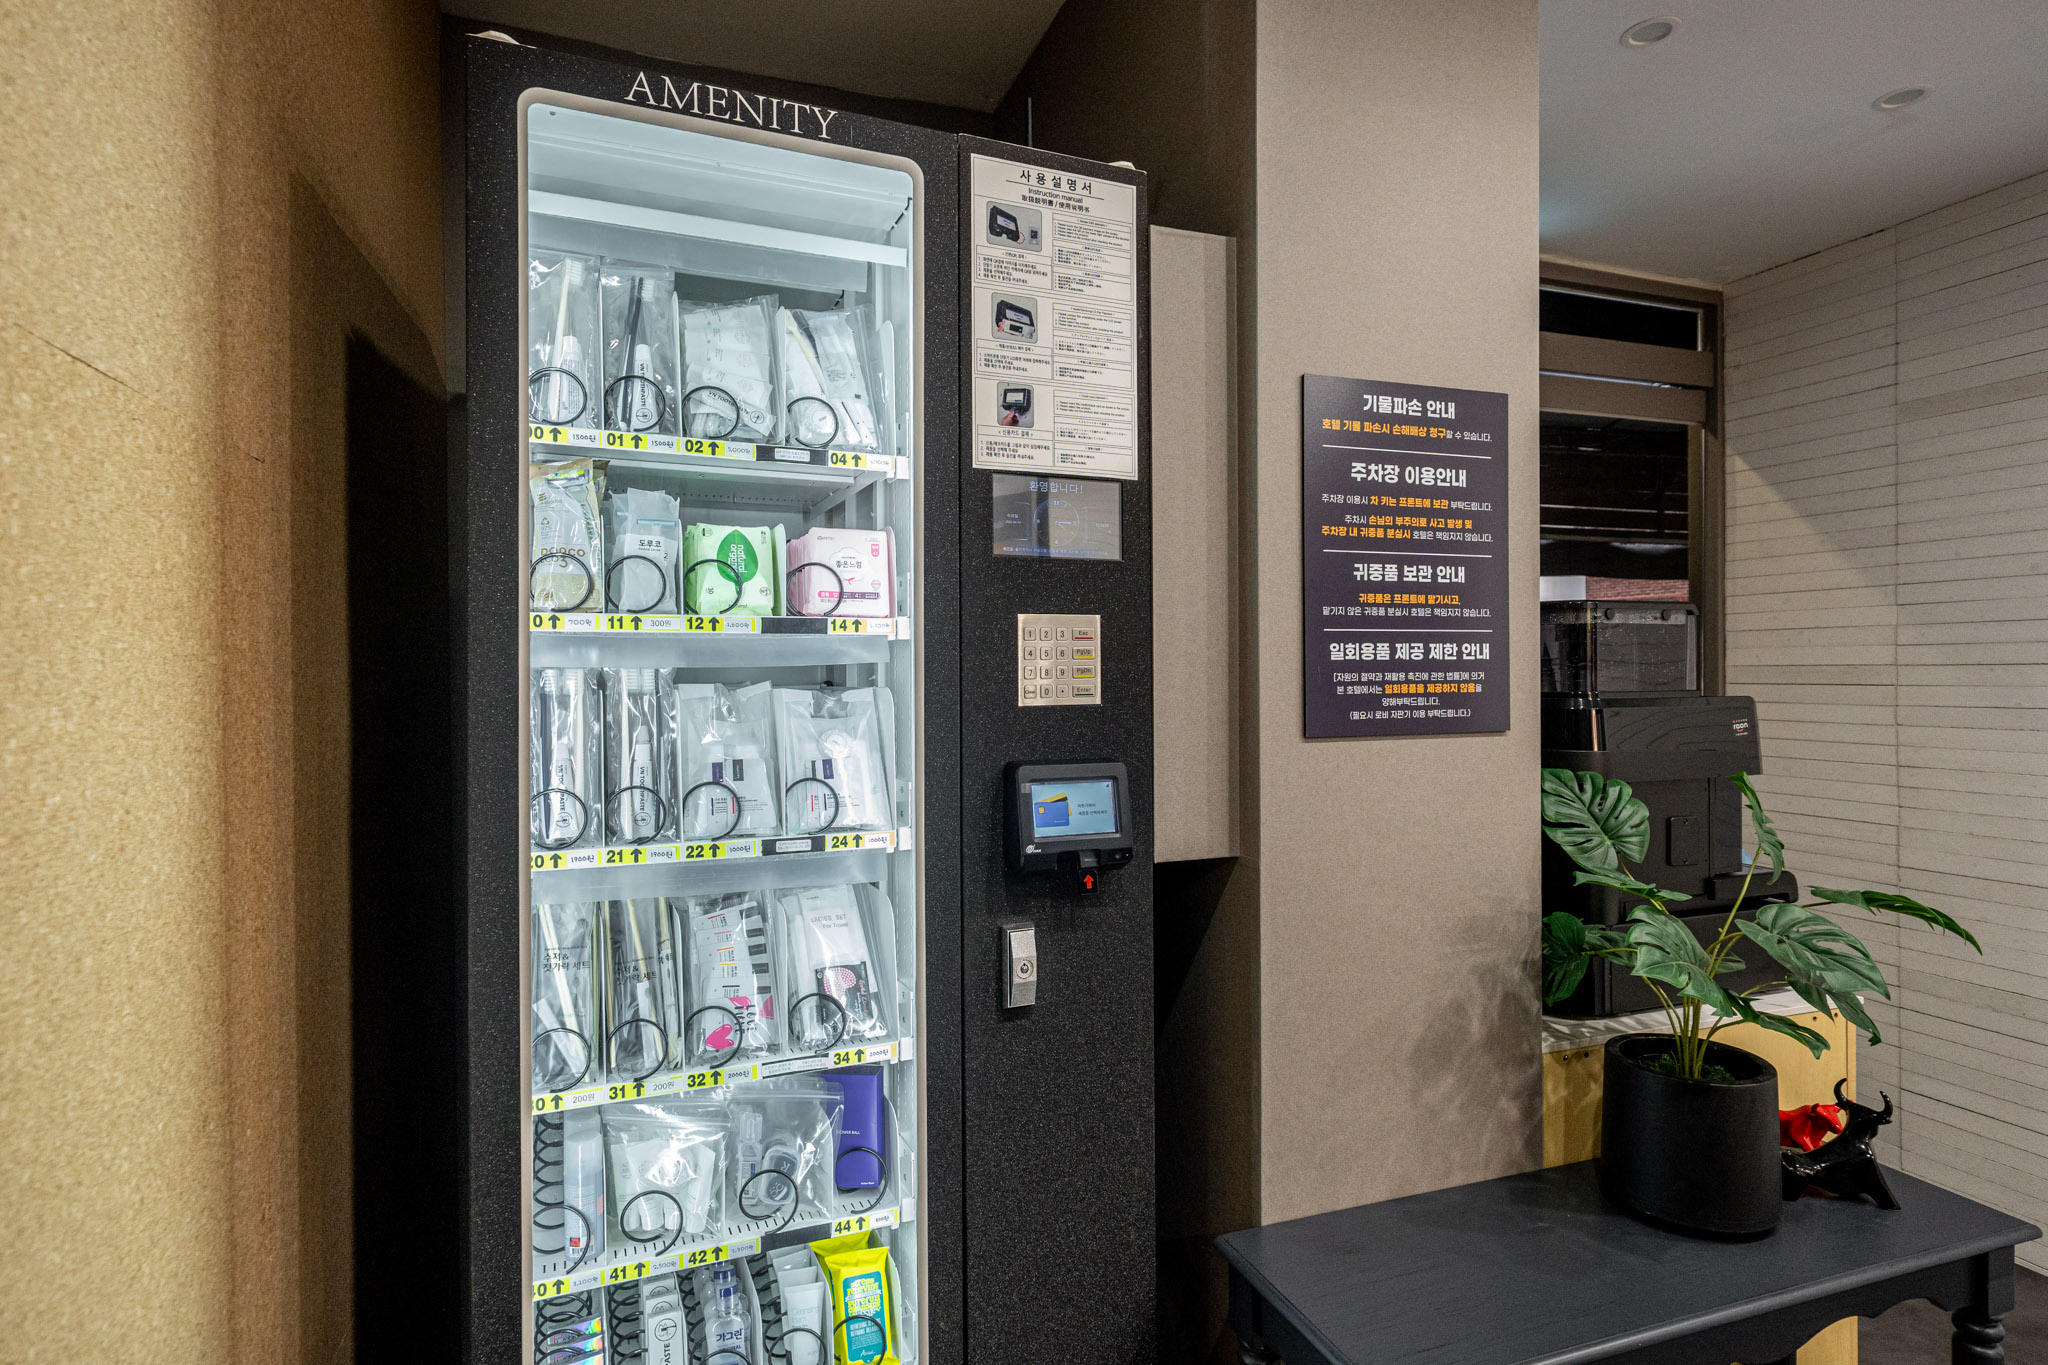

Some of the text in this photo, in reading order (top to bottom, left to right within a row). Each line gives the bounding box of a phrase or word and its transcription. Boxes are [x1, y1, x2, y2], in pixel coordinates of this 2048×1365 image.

[624, 71, 838, 139] AMENITY
[1029, 187, 1084, 204] Instruction manual
[1363, 395, 1456, 419] 기물파손 안내
[1322, 419, 1341, 431] 호텔
[1343, 421, 1361, 432] 기물
[1364, 422, 1390, 435] 파손시
[1392, 424, 1428, 437] 손해배상
[1454, 432, 1462, 440] 수
[1463, 432, 1493, 442] 있습니다.
[573, 434, 597, 443] 1500원
[607, 433, 674, 449] 01 1500원
[685, 439, 704, 454] 02
[831, 453, 848, 466] 04
[1351, 463, 1468, 488] 주차장 이용안내
[1029, 481, 1083, 494] 환영합니다!
[1322, 494, 1493, 512] 주차장 이용시 차 키는 프론트에 보관 부탁드립니다.
[1345, 515, 1473, 530] 주차시 손님의 부주의로 사고 발생 및
[1322, 526, 1494, 543] 주차장 내 귀중품 분실시 호텔은 책임지지 않습니다.
[638, 539, 662, 549] 도루코
[738, 545, 748, 573] natural
[836, 561, 862, 569] 좋은느낌
[1353, 564, 1466, 584] 귀중품 보관 안내
[1359, 593, 1392, 604] 귀중품은
[1394, 594, 1426, 605] 프론트에
[1347, 606, 1362, 616] 않은
[1364, 607, 1386, 617] 귀중품
[1388, 607, 1409, 617] 분실시
[1411, 608, 1432, 617] 호텔은
[1434, 608, 1461, 618] 책임지지
[1463, 608, 1492, 618] 않습니다.
[608, 616, 672, 630] 11 300원
[687, 617, 704, 630] 12
[831, 619, 848, 632] 14
[1330, 643, 1490, 661] 일회용품 제공 제한 안내
[1028, 669, 1033, 677] 7
[1361, 672, 1383, 682] 절약과
[1385, 672, 1406, 682] 재활용
[1408, 672, 1429, 682] 촉진에
[1431, 672, 1445, 682] 관한
[1471, 672, 1485, 681] 의거
[1336, 686, 1345, 695] 본
[1346, 686, 1383, 695] 호텔에서는
[1384, 684, 1425, 695] 일회용품을
[1427, 684, 1458, 694] 제공하지
[1350, 710, 1374, 720] (필요시
[1375, 710, 1389, 719] 로비
[1391, 710, 1411, 719] 자판기
[1413, 709, 1426, 719] 이용
[640, 767, 645, 775] VN
[832, 836, 849, 848] 24
[571, 854, 595, 863] 1900원
[607, 850, 673, 864] 21 1900원
[686, 845, 705, 859] 22
[544, 961, 591, 973] 젓가락 세트
[643, 971, 658, 980] 세트
[834, 1049, 889, 1065] 34 2000원
[687, 1070, 750, 1088] 32 2000원
[609, 1081, 675, 1100] 31 200원
[572, 1093, 595, 1104] 200원
[835, 1220, 852, 1234] 44
[689, 1251, 707, 1265] 42
[610, 1266, 627, 1281] 41
[716, 1328, 743, 1343] 가그린
